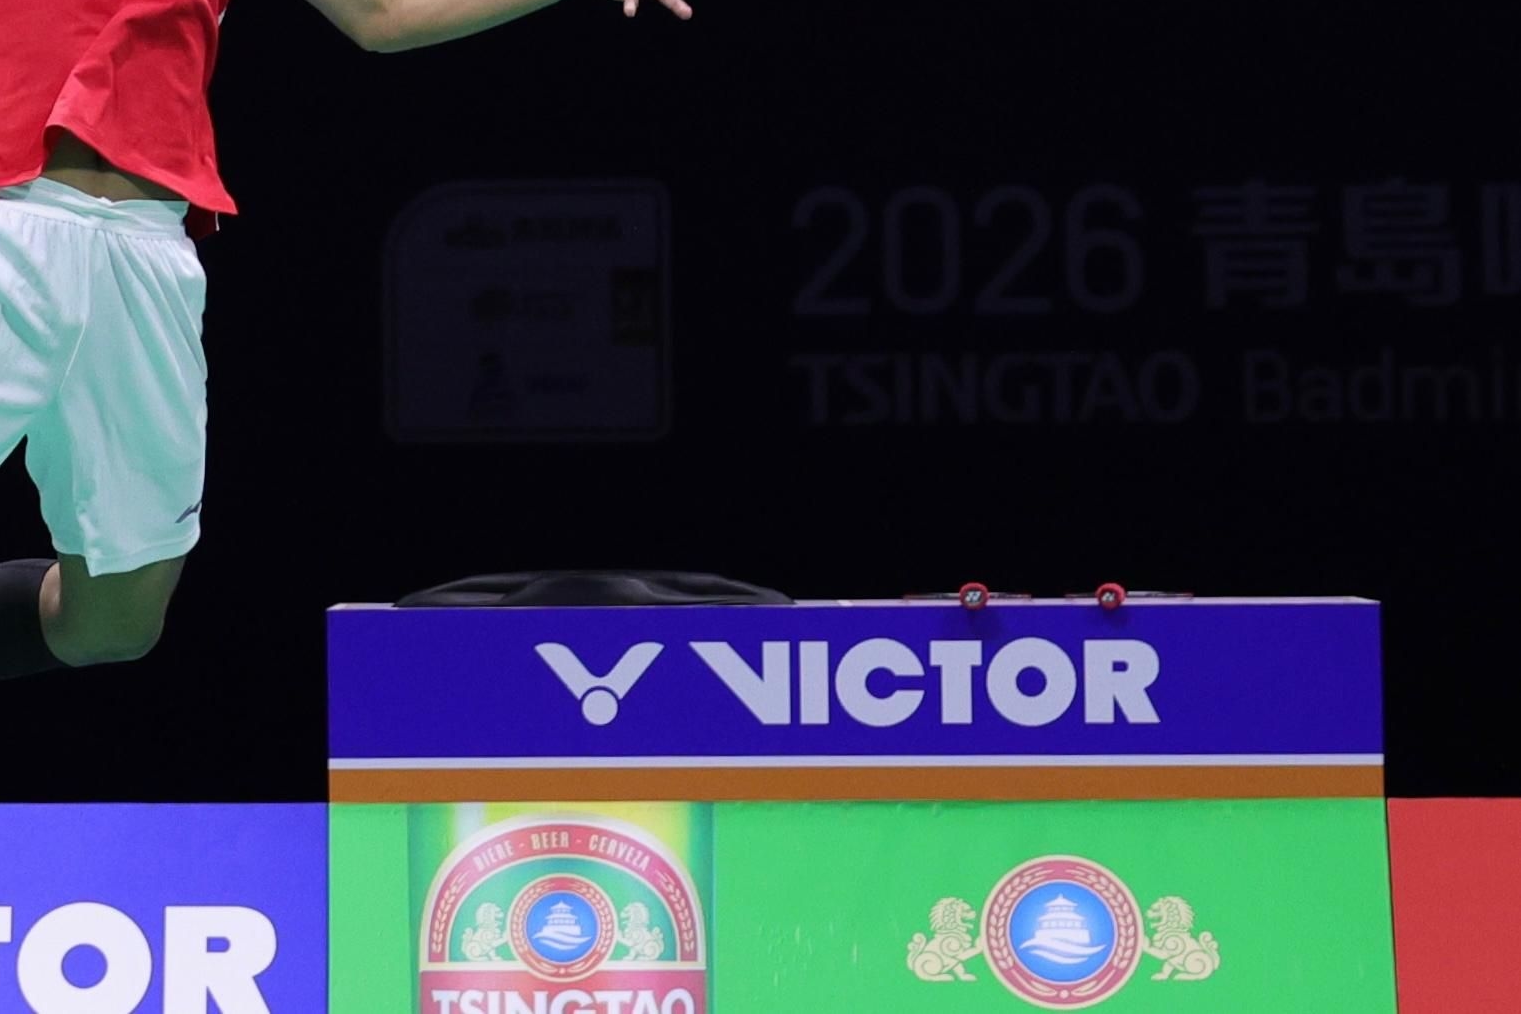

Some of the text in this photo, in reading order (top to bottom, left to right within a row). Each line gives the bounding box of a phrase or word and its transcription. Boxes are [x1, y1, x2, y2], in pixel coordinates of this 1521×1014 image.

[791, 183, 1146, 315] 2026
[787, 344, 1521, 427] TSINGTAO Badmi
[689, 637, 1161, 727] VICTOR
[531, 831, 570, 850] BEER
[588, 834, 651, 872] CERVEZA
